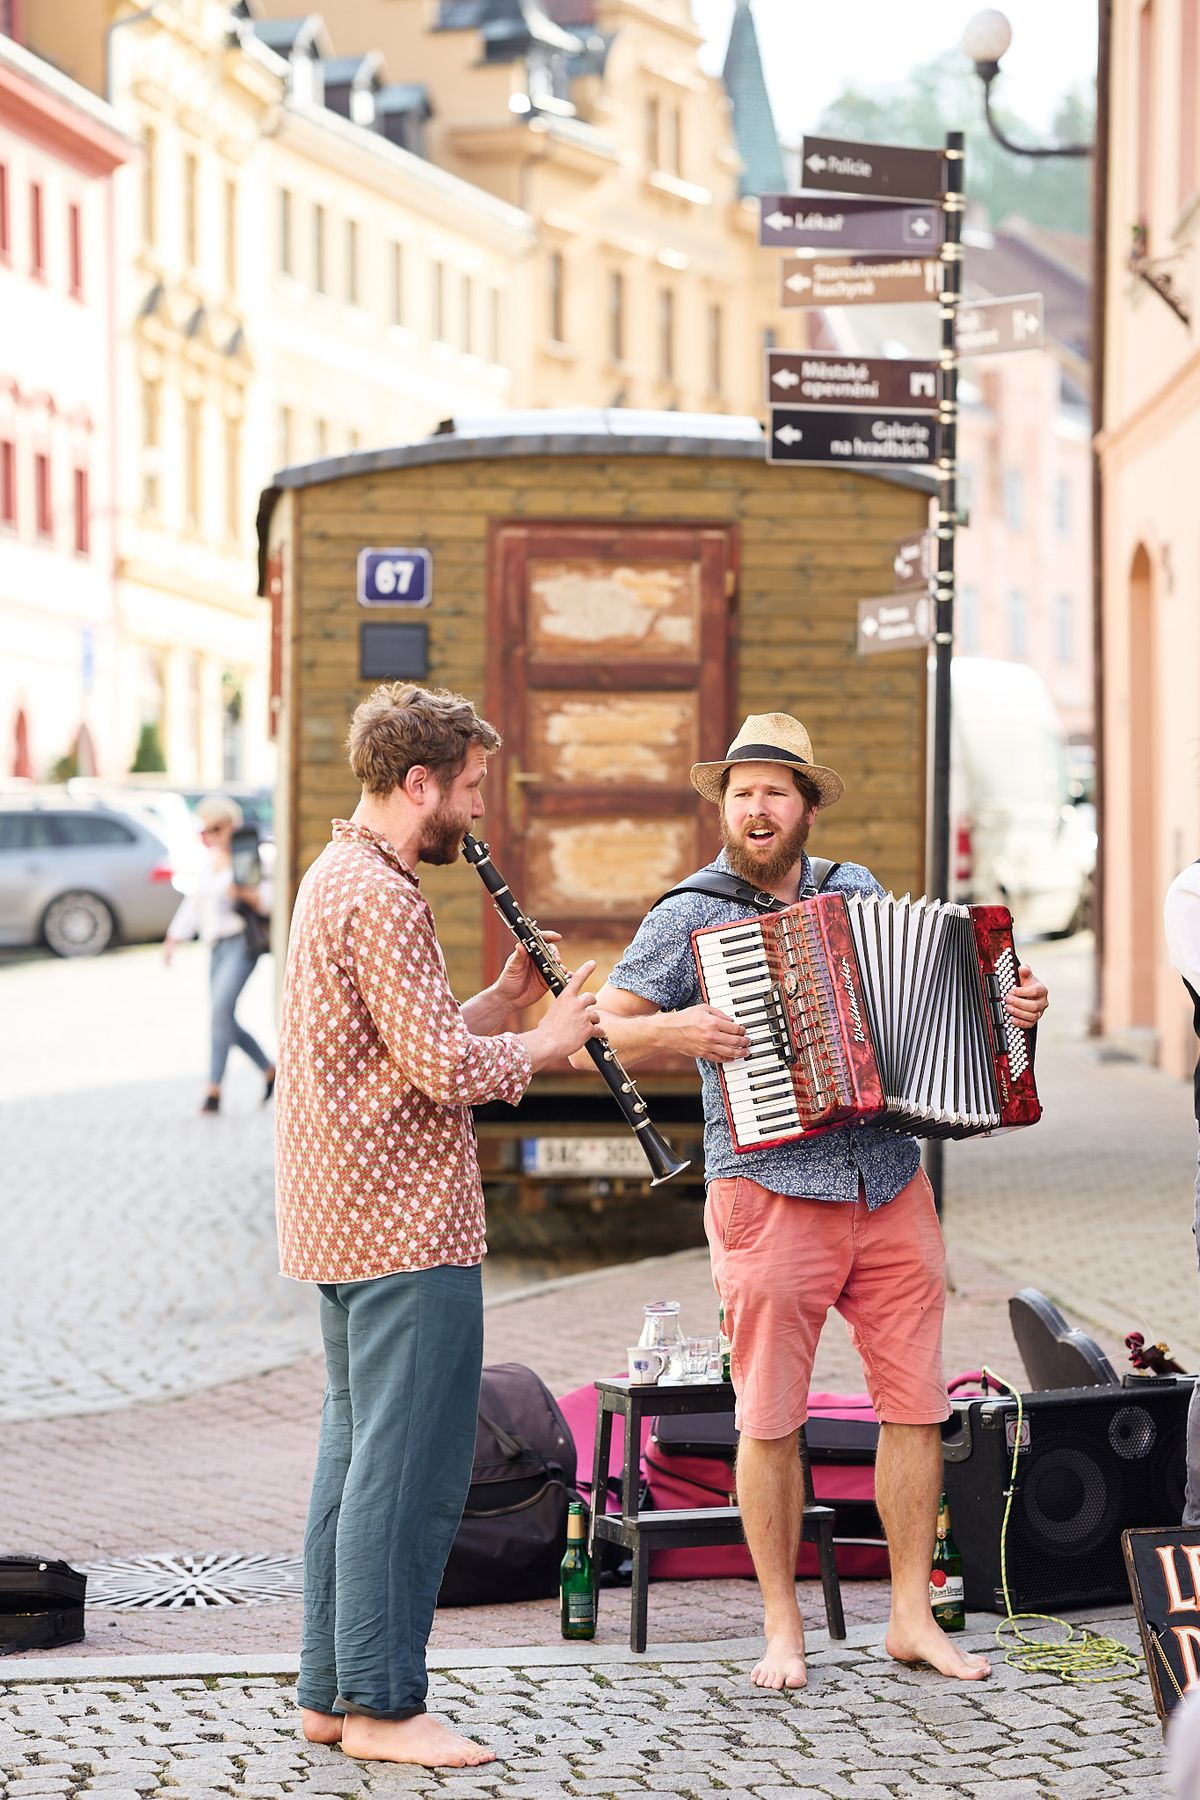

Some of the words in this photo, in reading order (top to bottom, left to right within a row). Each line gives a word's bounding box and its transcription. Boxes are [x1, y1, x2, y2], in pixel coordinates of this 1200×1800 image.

[801, 361, 869, 383] Městské
[801, 381, 879, 400] opevnění
[871, 421, 930, 442] Galerie
[830, 438, 851, 456] na
[853, 438, 930, 459] hradbách
[374, 559, 416, 595] 67
[840, 957, 865, 1042] Weltmeister
